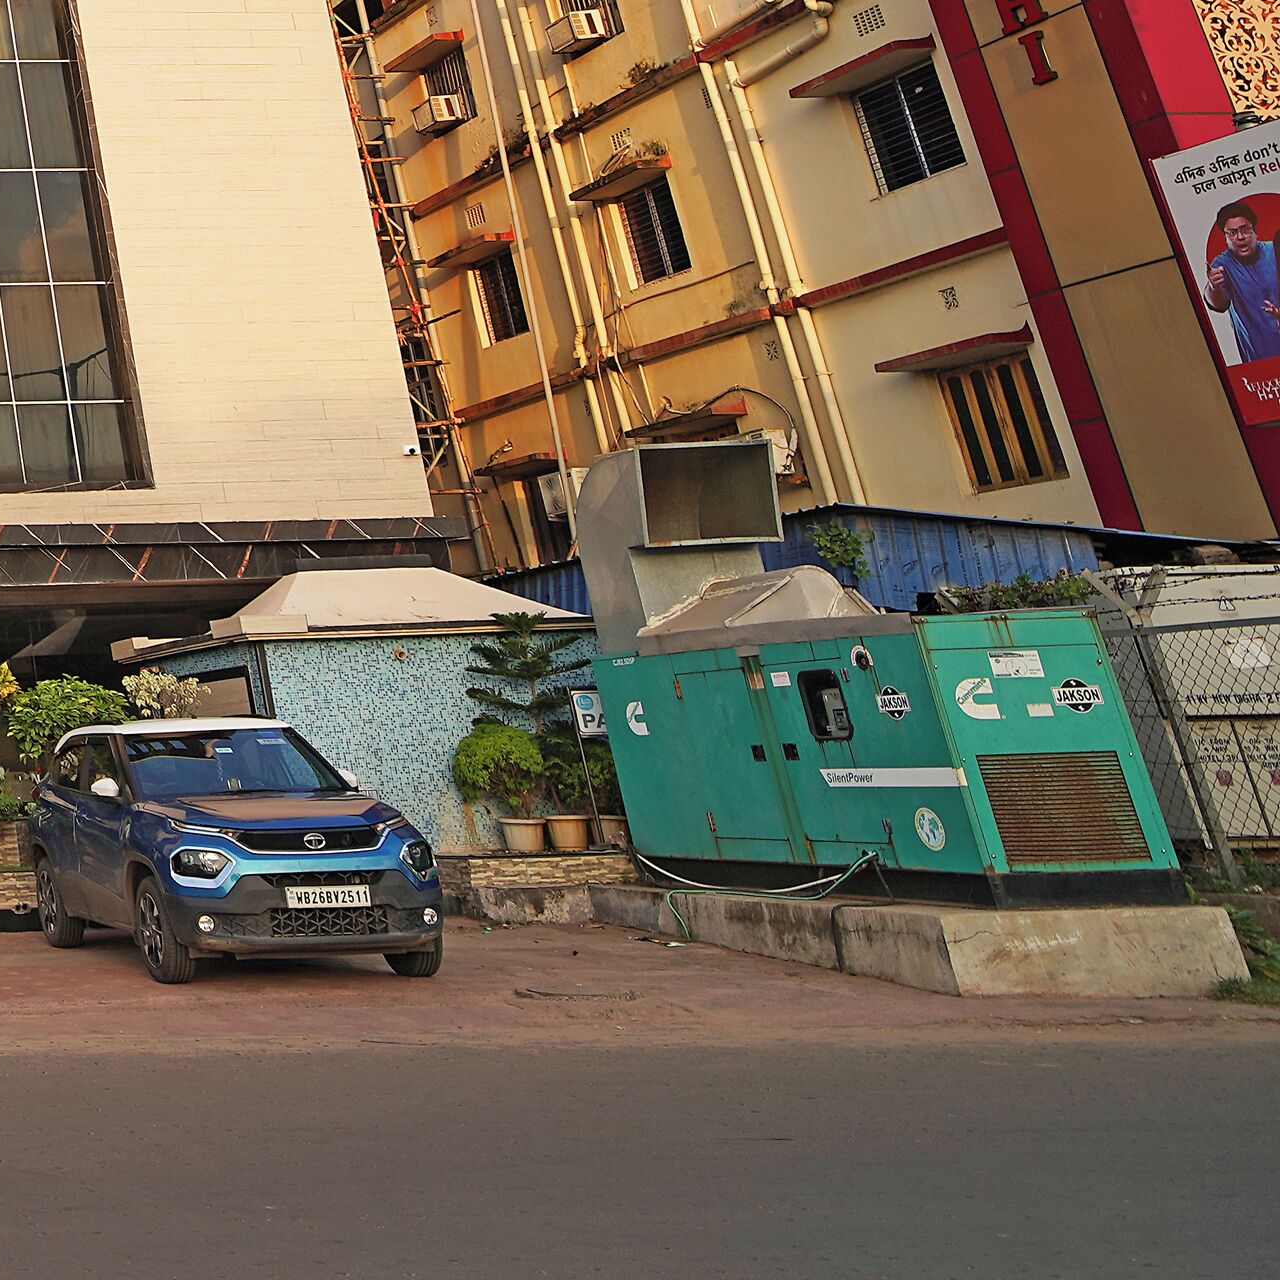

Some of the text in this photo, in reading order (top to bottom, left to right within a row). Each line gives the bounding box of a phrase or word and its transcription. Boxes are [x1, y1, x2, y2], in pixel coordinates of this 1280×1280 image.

[1174, 165, 1206, 184] এদিক
[1209, 155, 1241, 173] ওদিক
[1192, 178, 1217, 195] চলে
[1217, 166, 1257, 186] আসুন
[957, 678, 987, 705] Cummins
[1056, 689, 1101, 703] JAKSON
[879, 696, 909, 711] JAKSON
[827, 773, 873, 783] SilentPower
[296, 890, 368, 904] WB26BV2511
